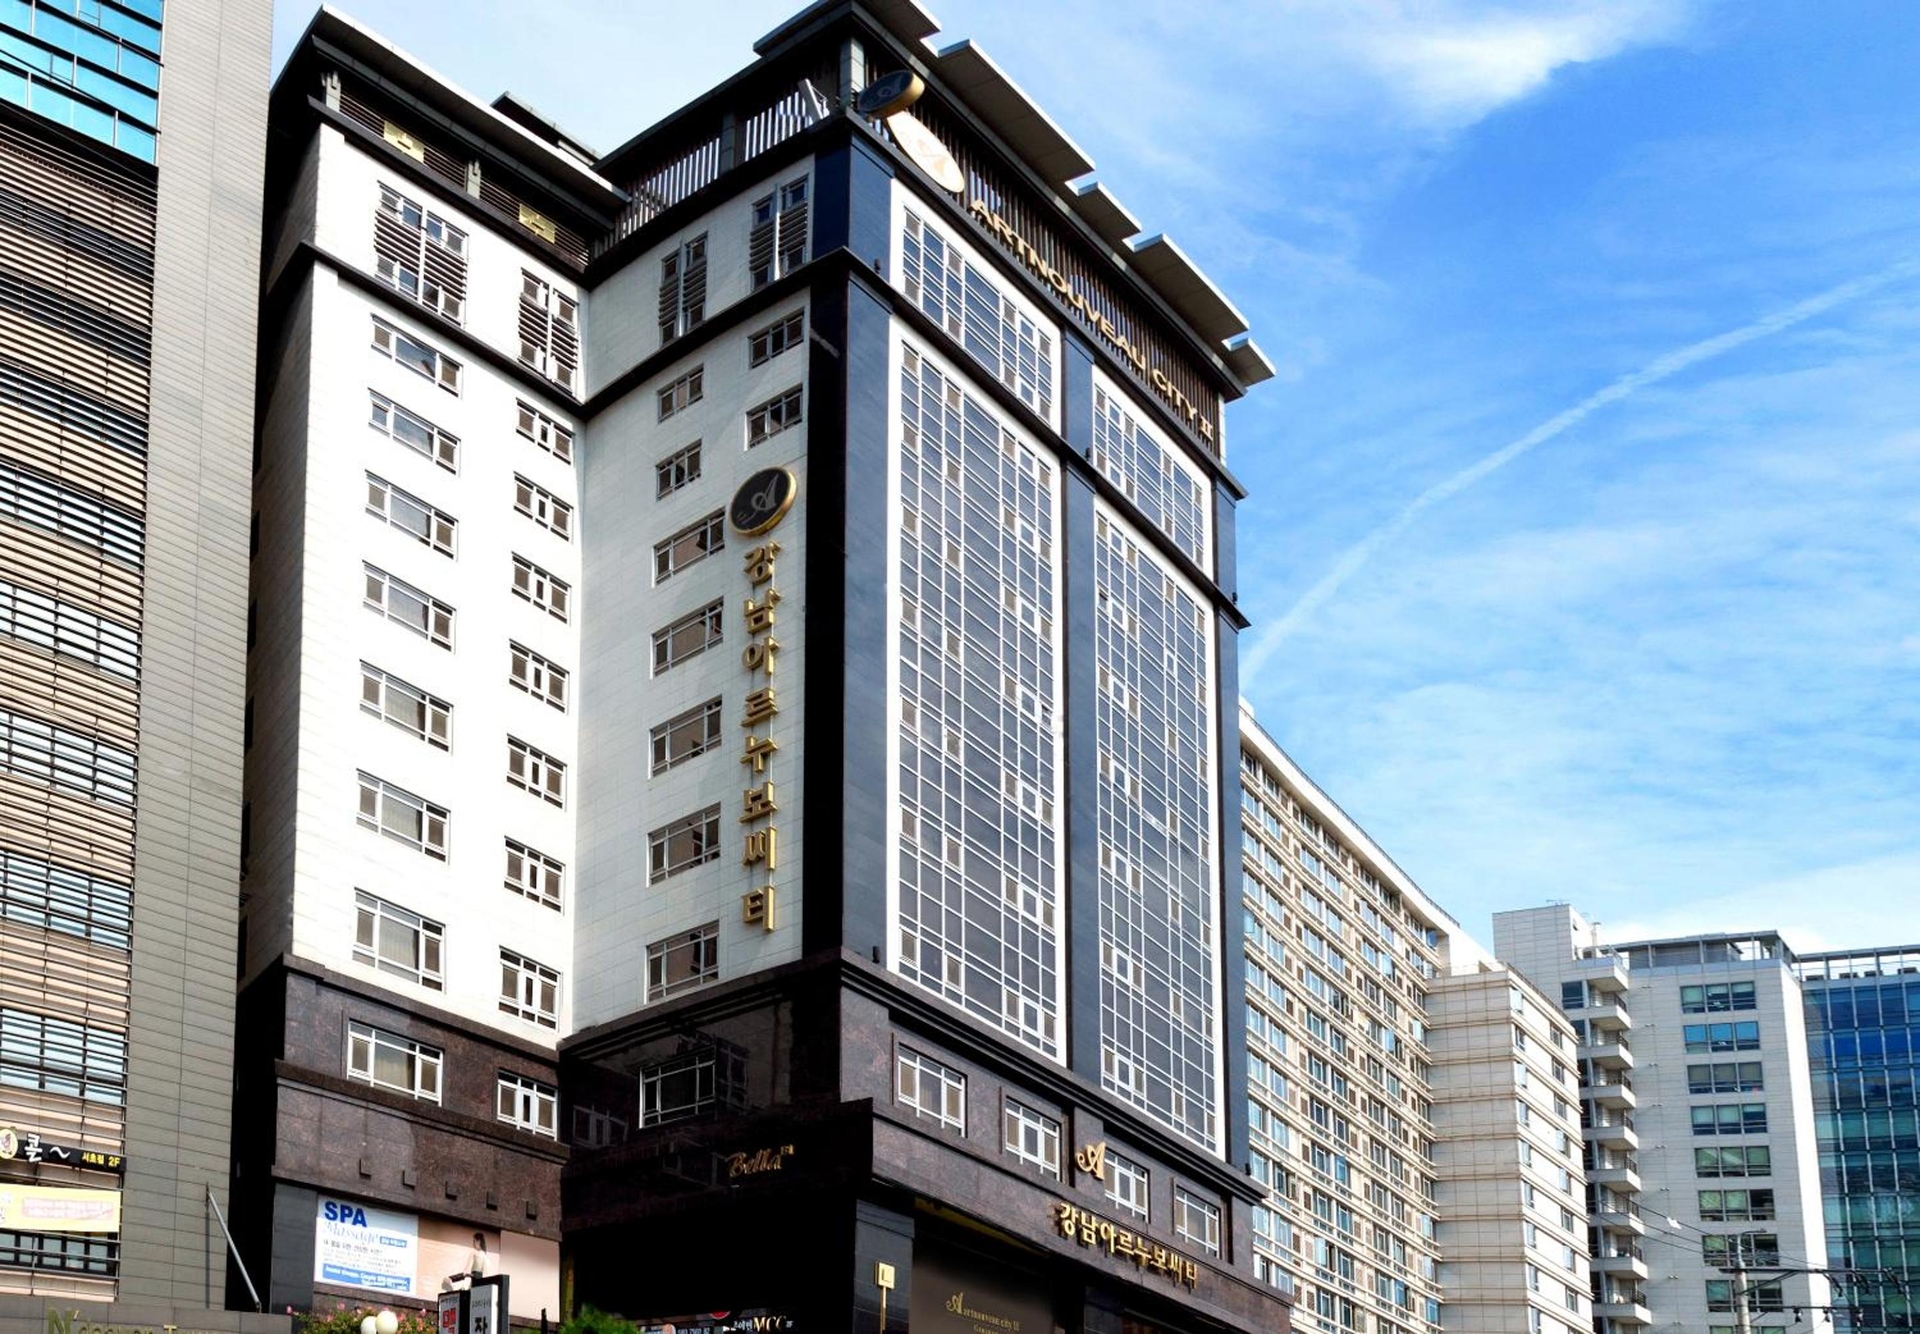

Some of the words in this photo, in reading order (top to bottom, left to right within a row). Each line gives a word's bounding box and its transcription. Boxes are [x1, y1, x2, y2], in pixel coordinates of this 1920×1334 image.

[1152, 369, 1198, 420] CITY
[739, 540, 782, 933] 강남아르누보씨티
[108, 1156, 121, 1168] 2F
[324, 1201, 367, 1228] SPA
[1059, 1203, 1197, 1289] 강남아르누보씨티
